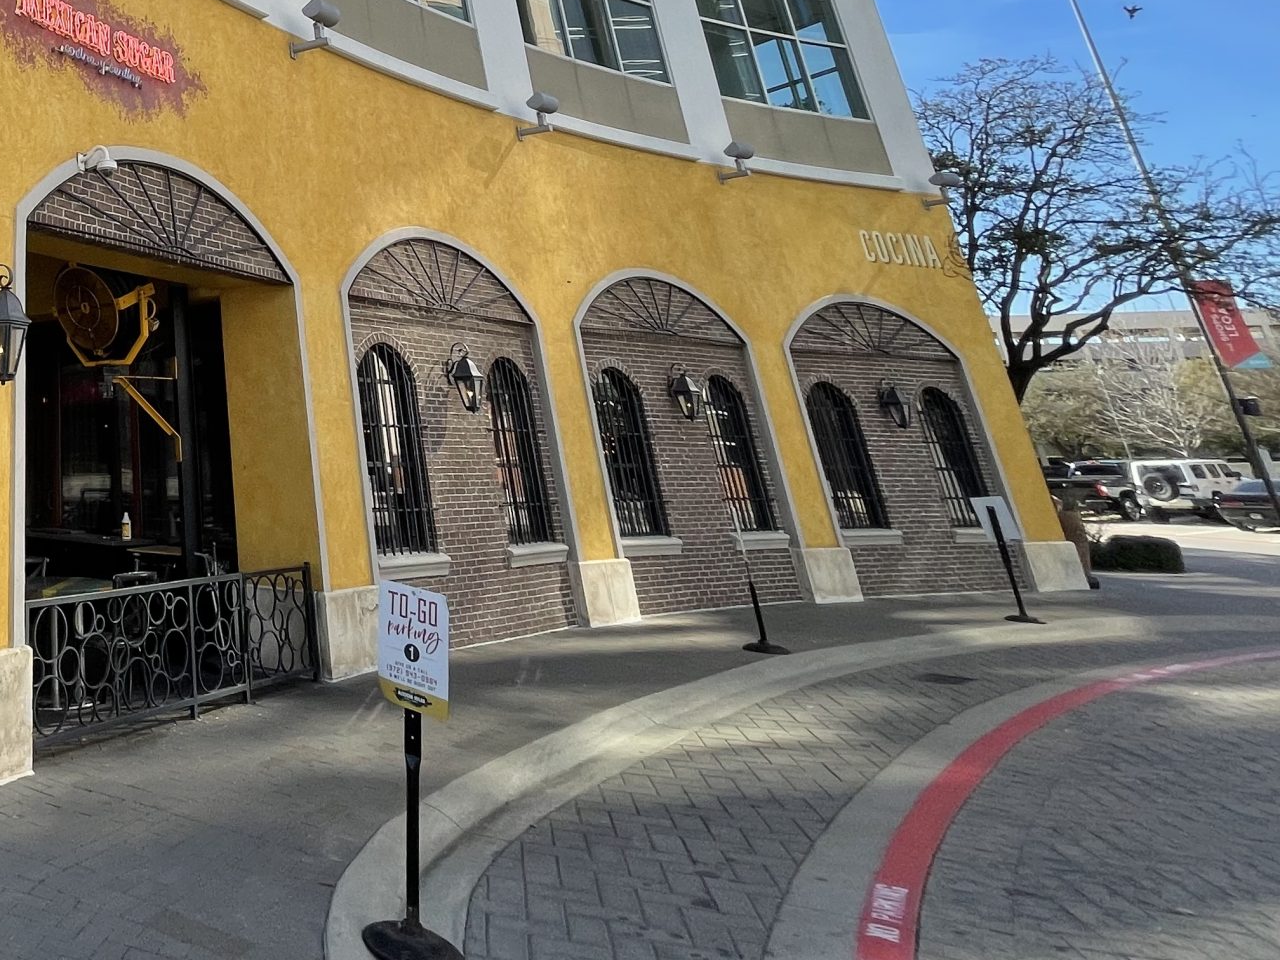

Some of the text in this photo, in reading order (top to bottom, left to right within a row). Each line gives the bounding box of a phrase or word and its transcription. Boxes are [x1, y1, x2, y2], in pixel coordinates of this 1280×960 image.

[113, 30, 176, 84] SUGAR
[859, 229, 942, 268] COCINA
[388, 590, 438, 627] TO-GO
[387, 618, 443, 654] parking
[408, 646, 415, 660] 1
[865, 923, 900, 944] NO
